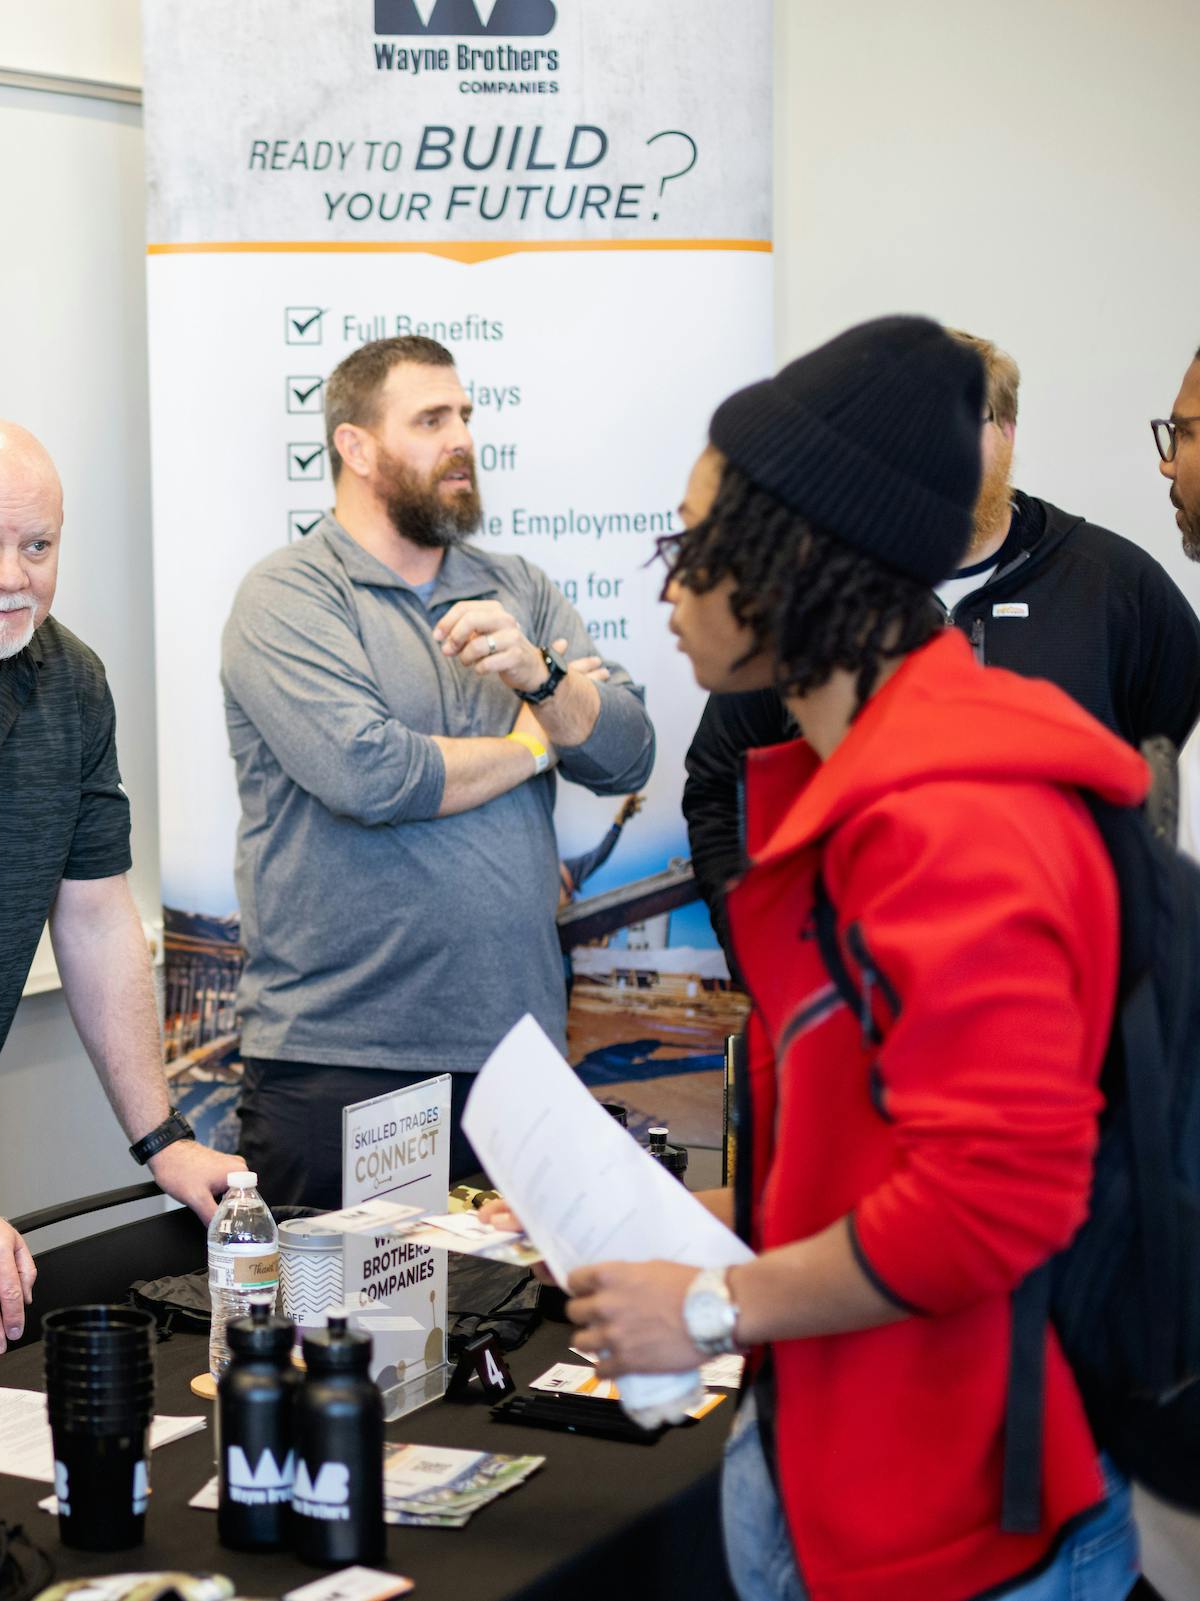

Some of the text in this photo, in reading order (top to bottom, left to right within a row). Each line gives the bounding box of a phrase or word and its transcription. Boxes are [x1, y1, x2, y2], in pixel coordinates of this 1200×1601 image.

[374, 43, 560, 75] Wayne Brothers
[459, 81, 559, 94] COMPANIES
[249, 125, 608, 171] READY TO BUILD
[323, 192, 432, 221] YOUR
[343, 314, 504, 342] Full Benefits
[481, 443, 518, 472] Off
[512, 508, 673, 541] Employment
[587, 573, 624, 599] for
[355, 1106, 439, 1149] SKILLED TRADES
[355, 1129, 439, 1183] CONNECT
[359, 1258, 434, 1308] COMPANIES
[484, 1349, 506, 1390] 4
